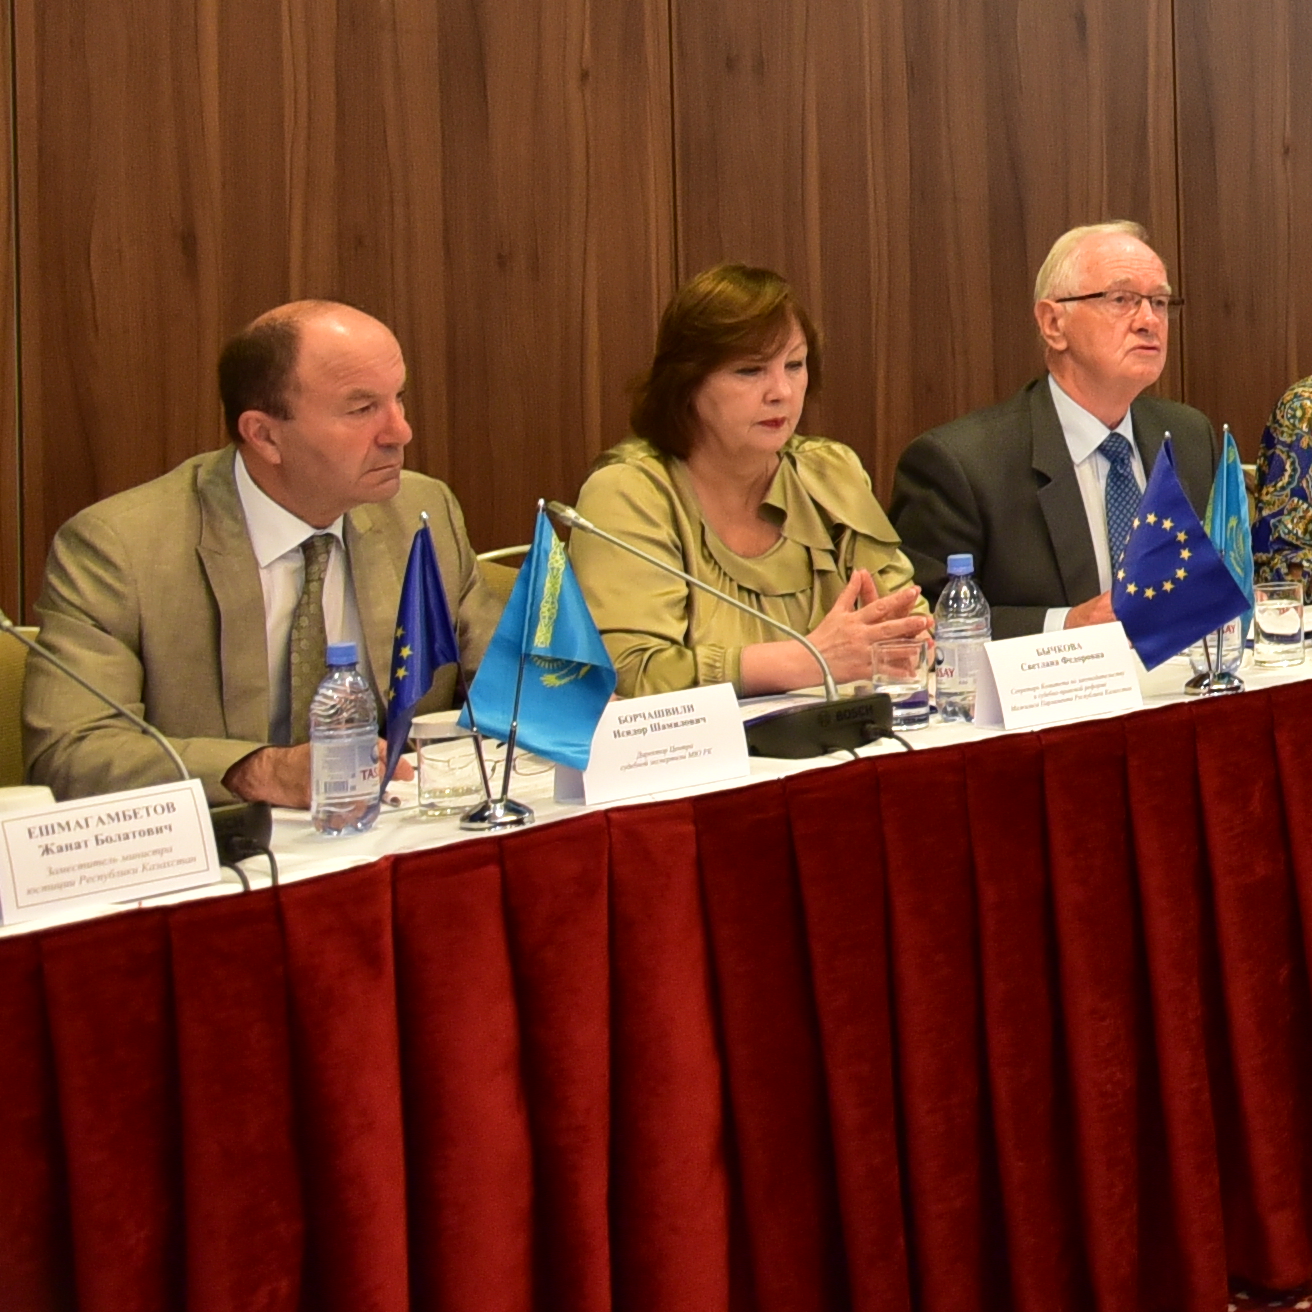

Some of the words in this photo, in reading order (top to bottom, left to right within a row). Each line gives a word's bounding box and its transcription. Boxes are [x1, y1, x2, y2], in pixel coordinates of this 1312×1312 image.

[1036, 643, 1082, 656] БЫЧКОВА
[618, 704, 695, 725] БОРЧАШВИЛИ
[27, 801, 177, 840] ЕШМАГАМБЕТОВ
[37, 838, 89, 857] Жанат
[94, 823, 172, 846] Болатович
[79, 867, 138, 886] Республики
